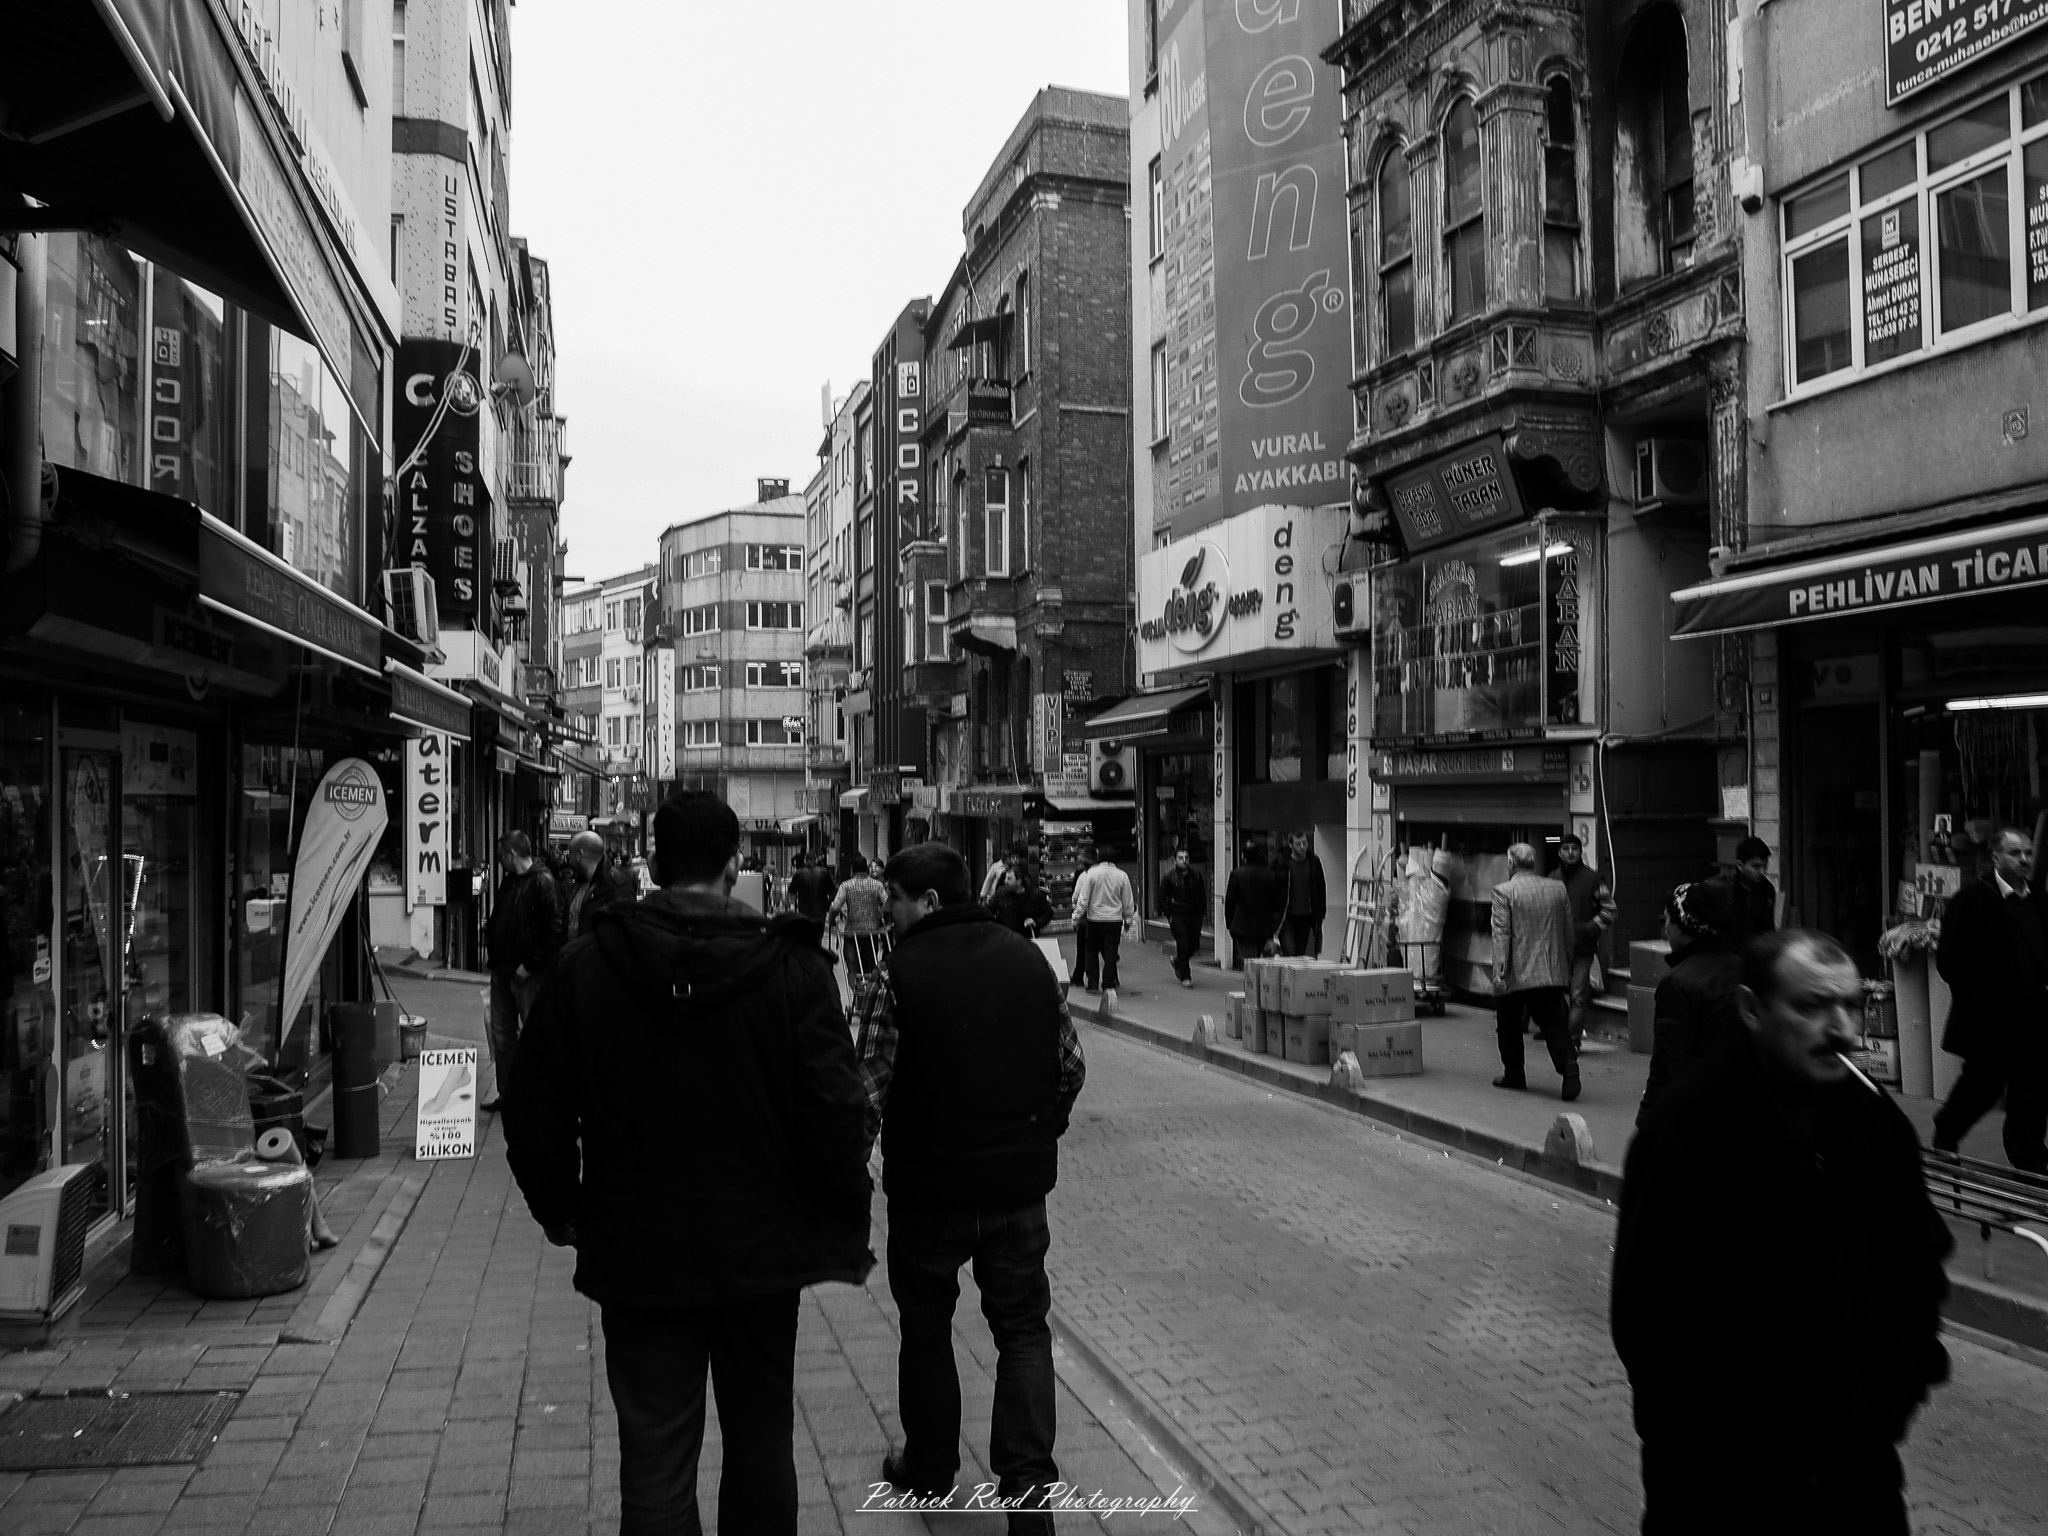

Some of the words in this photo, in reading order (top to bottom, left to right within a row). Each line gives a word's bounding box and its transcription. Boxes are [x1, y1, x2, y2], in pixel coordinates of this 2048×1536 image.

[1915, 16, 1967, 63] 0212
[1160, 40, 1180, 152] 60
[1235, 0, 1331, 409] eng
[1872, 243, 1909, 271] SERBEST
[1891, 278, 1919, 304] DURAN
[1250, 431, 1326, 460] VURAL
[1234, 459, 1346, 494] AYAKKABI
[1442, 454, 1497, 492] HÜNER
[1451, 479, 1503, 513] TABAN
[453, 451, 475, 601] SHOES
[1273, 521, 1297, 640] deng
[1788, 563, 1941, 615] PEHLİVAN
[1164, 580, 1217, 637] deng
[1426, 592, 1480, 626] TABAN
[1555, 553, 1581, 674] TABAN
[1348, 680, 1358, 799] deng
[1399, 751, 1438, 777] BAŞAR
[329, 785, 375, 804] ICEMEN
[296, 828, 351, 935] www.icemen.com.tr
[421, 1052, 476, 1066] ICEMEN
[420, 1141, 472, 1157] SİLİKON
